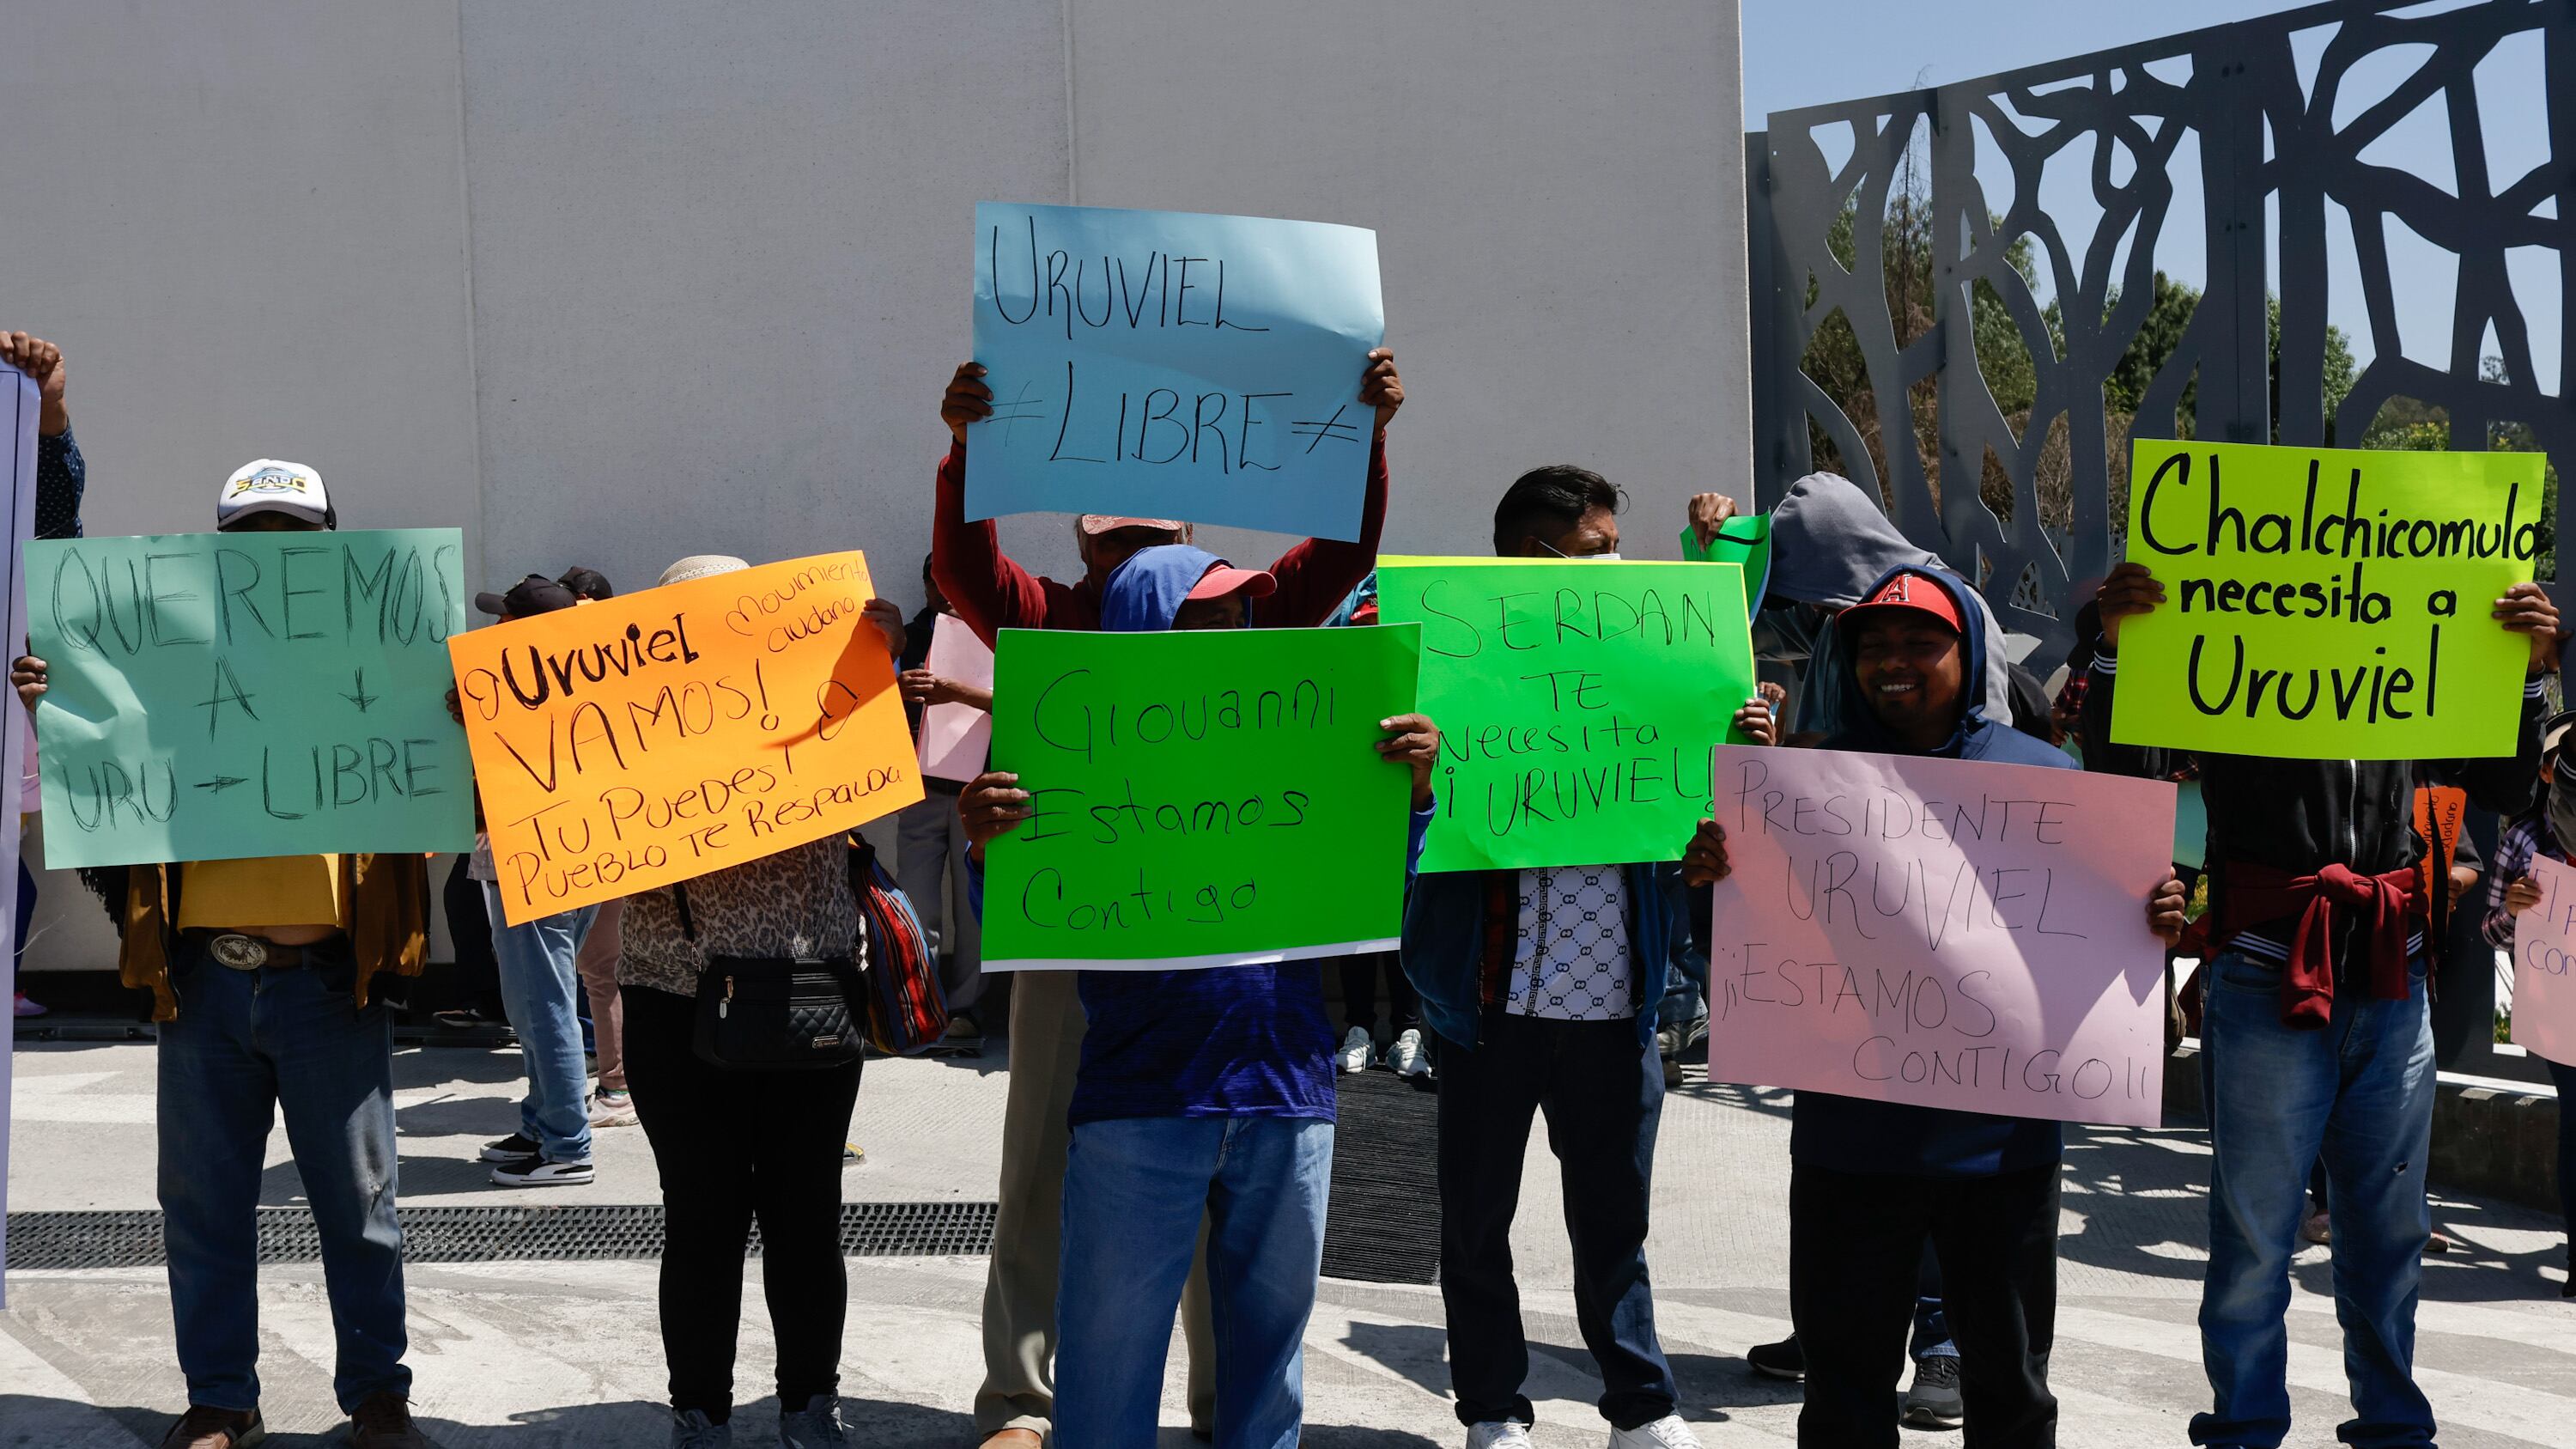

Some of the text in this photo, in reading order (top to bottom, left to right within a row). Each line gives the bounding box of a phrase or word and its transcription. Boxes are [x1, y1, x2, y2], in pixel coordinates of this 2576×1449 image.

[993, 216, 1270, 340] URUVIEL
[1049, 361, 1293, 475] LIBRE
[2140, 452, 2543, 561] Chalchicomula
[52, 544, 456, 659] QUEREMOS
[1421, 579, 1716, 658] SERDAN
[1878, 573, 1912, 603] A
[2180, 562, 2458, 624] necesita a
[193, 654, 261, 743] A
[1519, 670, 1609, 712] TE
[2188, 624, 2439, 724] Uruviel
[495, 658, 779, 794] VAMOS!
[63, 737, 447, 832] URU LIBRE
[1020, 778, 1309, 844] Estamos
[1734, 759, 2076, 848] PRESIDENTE
[1023, 867, 1256, 930] Contigo
[1787, 851, 2088, 953] URUVIEL
